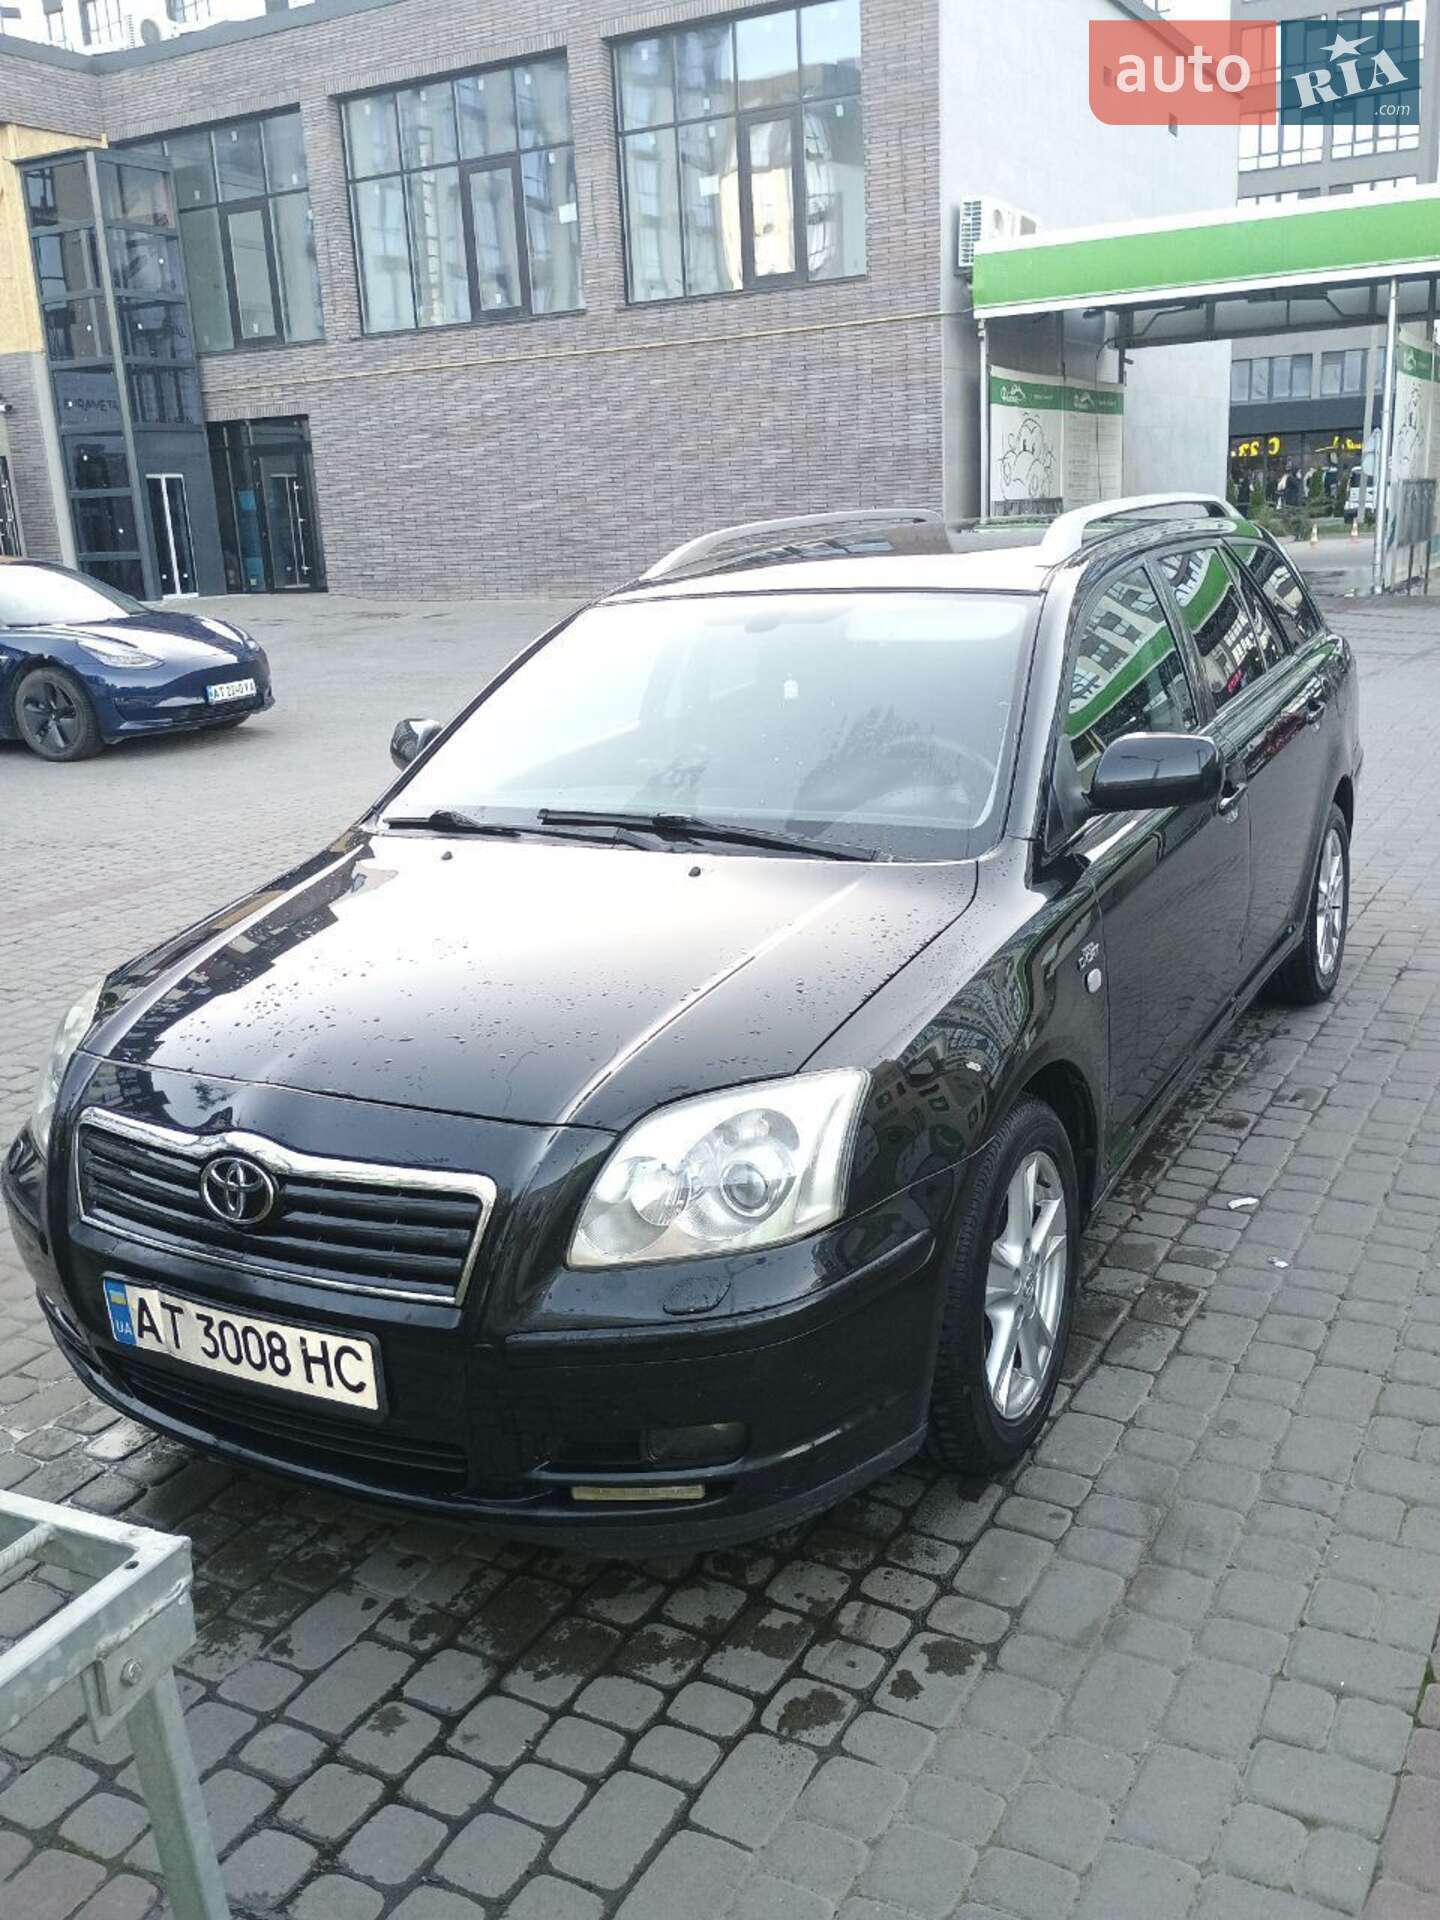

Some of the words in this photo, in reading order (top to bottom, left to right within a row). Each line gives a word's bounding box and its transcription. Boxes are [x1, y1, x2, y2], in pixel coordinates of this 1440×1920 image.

[115, 1319, 133, 1336] UA
[136, 1297, 184, 1349] AT
[196, 1313, 292, 1378] 3008
[299, 1336, 367, 1394] HC
